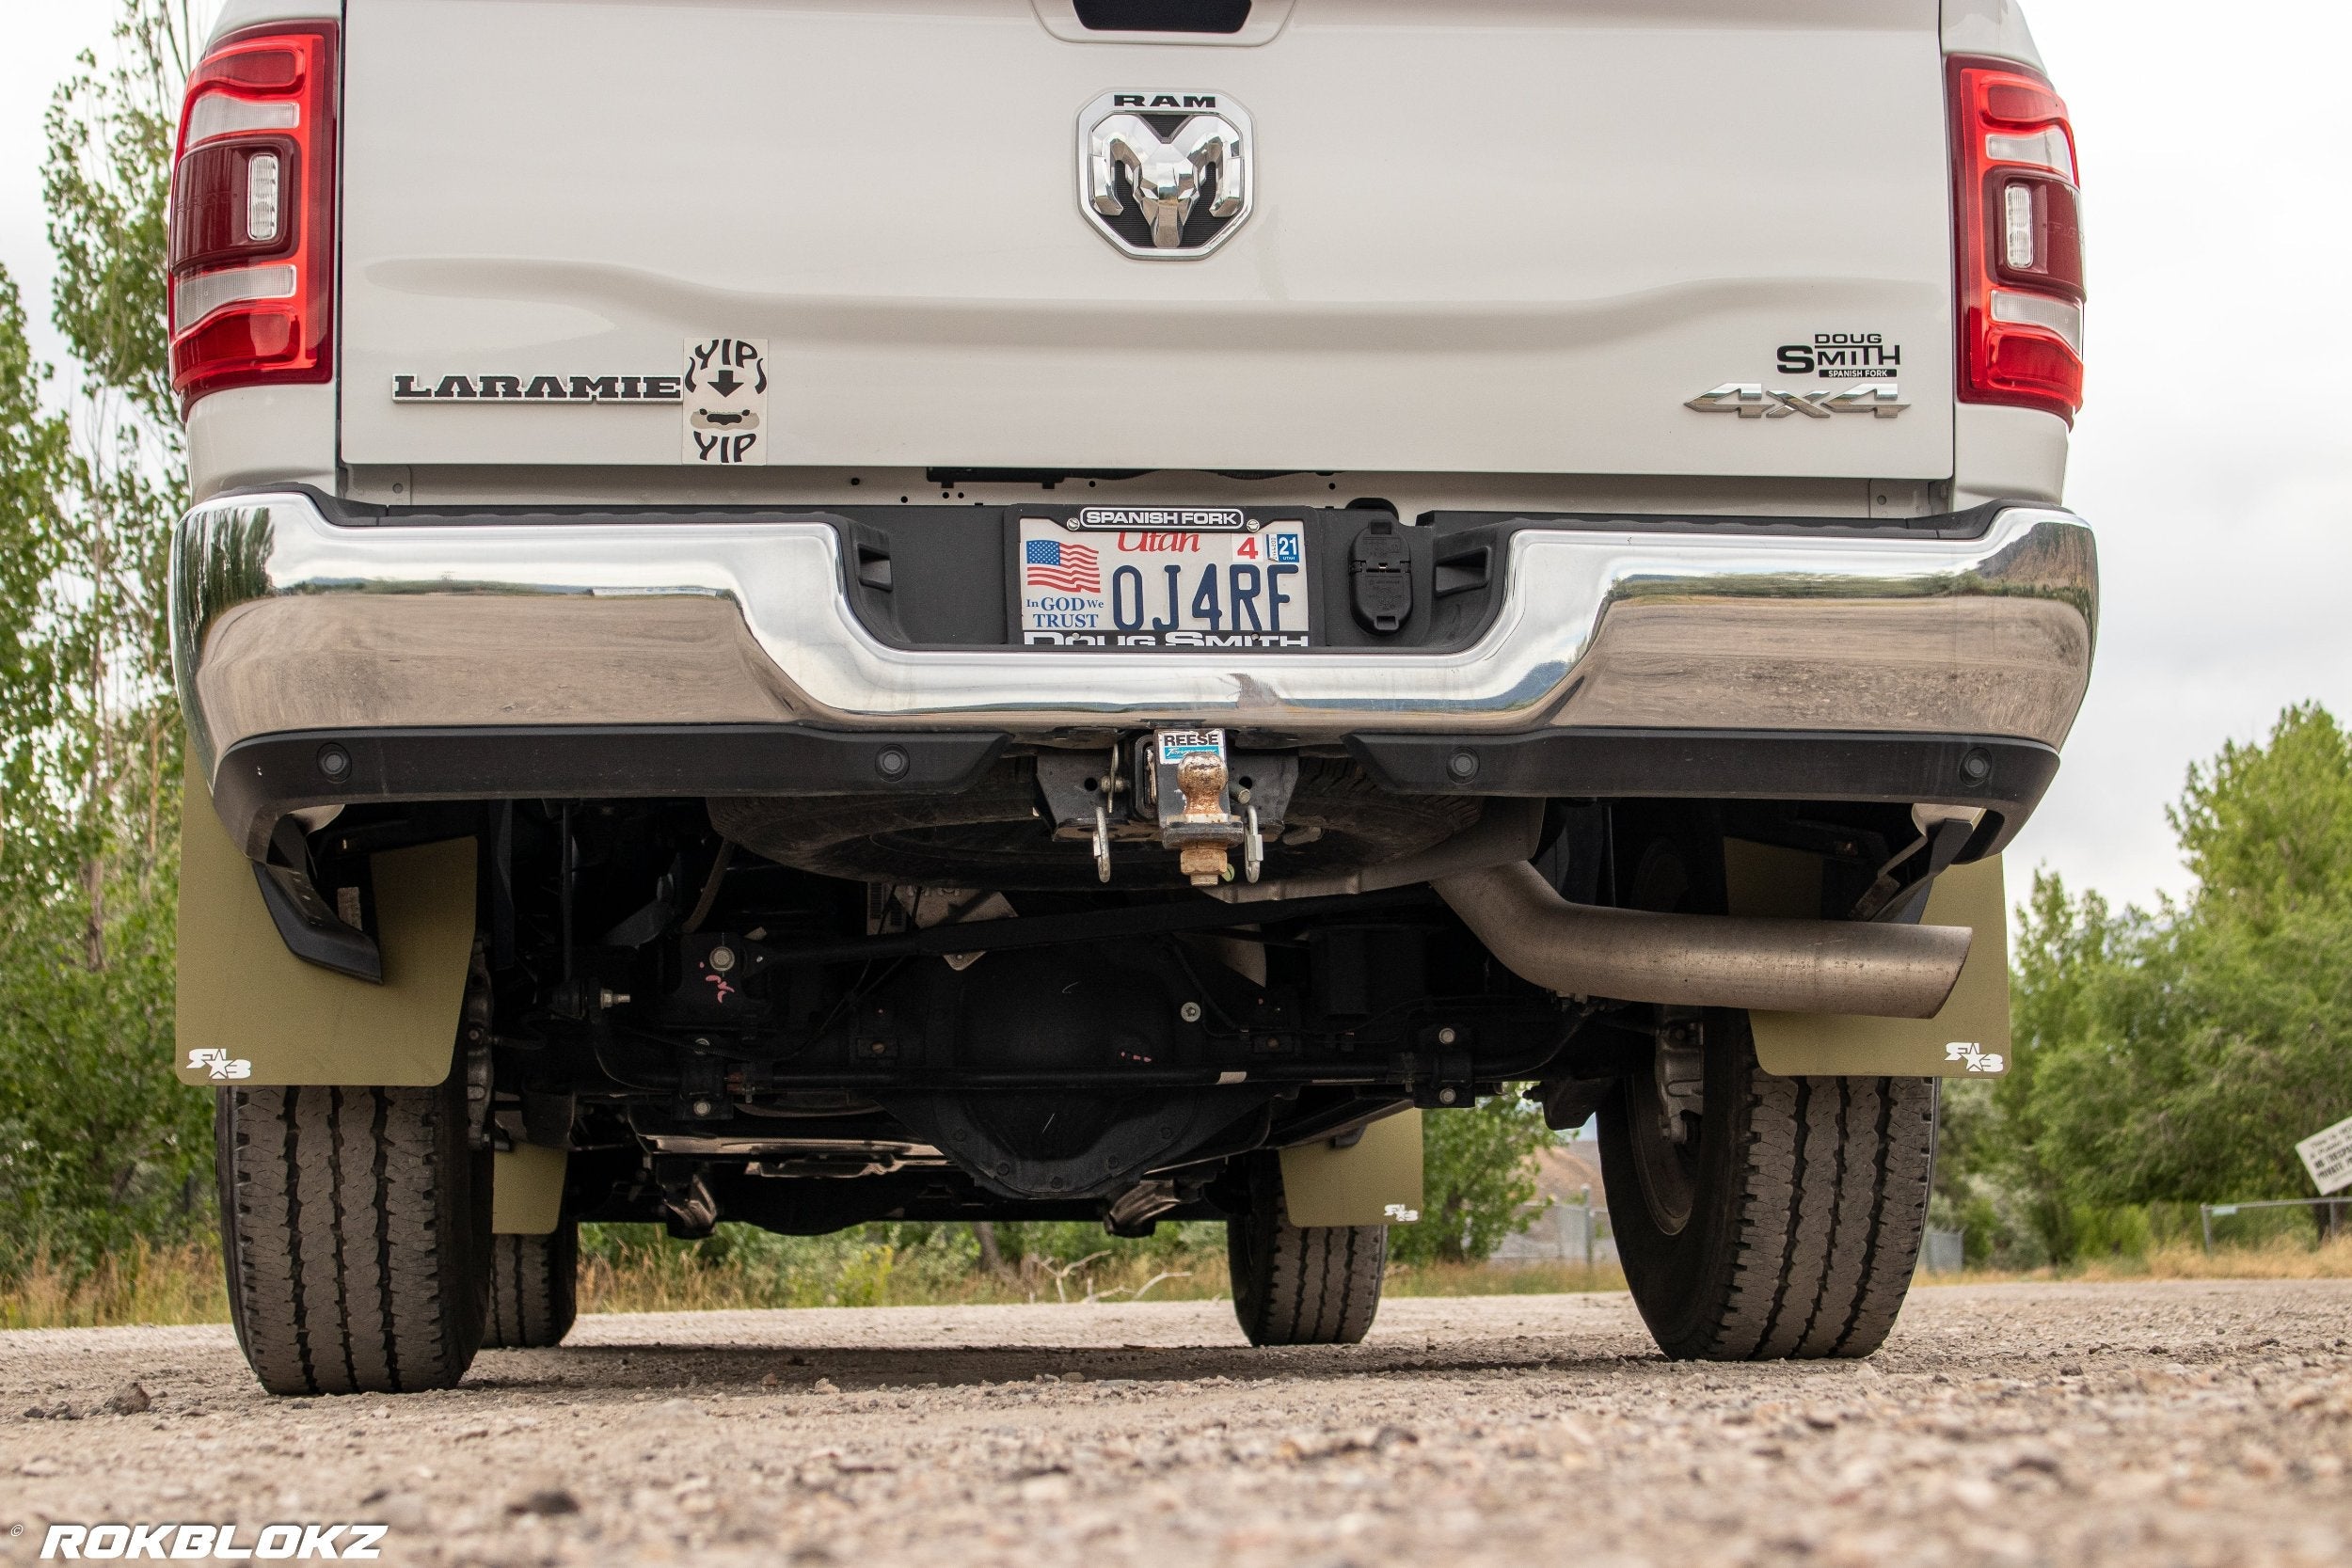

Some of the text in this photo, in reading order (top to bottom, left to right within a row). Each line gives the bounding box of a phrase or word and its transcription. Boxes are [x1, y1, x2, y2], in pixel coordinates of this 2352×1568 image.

[1114, 95, 1216, 108] RAM
[1815, 334, 1882, 344] DOUG
[694, 339, 758, 370] YIP
[1777, 344, 1900, 373] SMITH
[393, 375, 682, 400] LARAMIE
[693, 431, 756, 463] YIP
[1087, 512, 1236, 526] SPANISH FORK
[1237, 537, 1259, 559] 4
[1279, 537, 1297, 555] 21
[1026, 597, 1104, 611] In GOD We
[1032, 613, 1099, 628] TRUST
[1164, 735, 1218, 746] REESE
